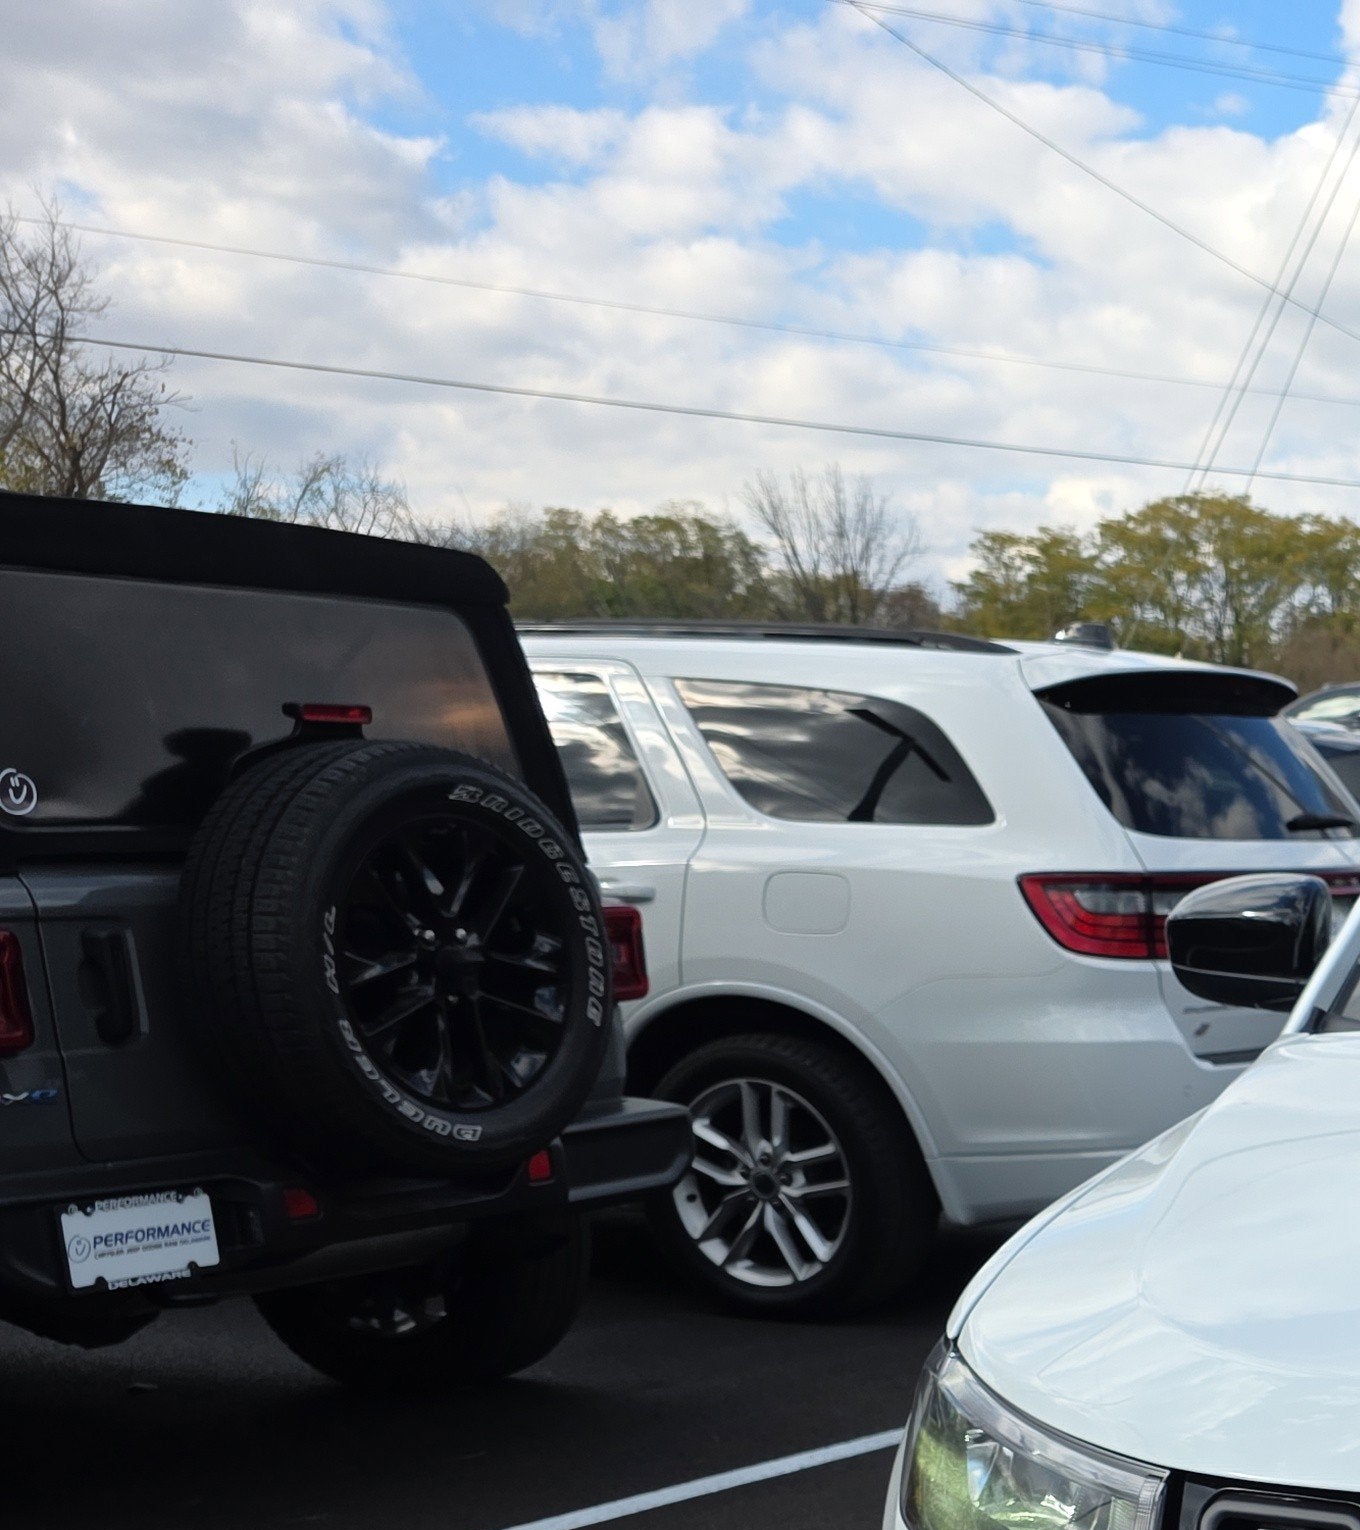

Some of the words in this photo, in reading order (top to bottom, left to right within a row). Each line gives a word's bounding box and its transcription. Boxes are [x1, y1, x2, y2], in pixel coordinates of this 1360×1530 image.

[448, 785, 606, 1028] BRIDGESTONE
[336, 1016, 483, 1142] DUELER
[95, 1190, 178, 1213] PERFORMANCE
[93, 1219, 211, 1250] PERFORMANCE
[108, 1268, 192, 1291] DELAWARE
